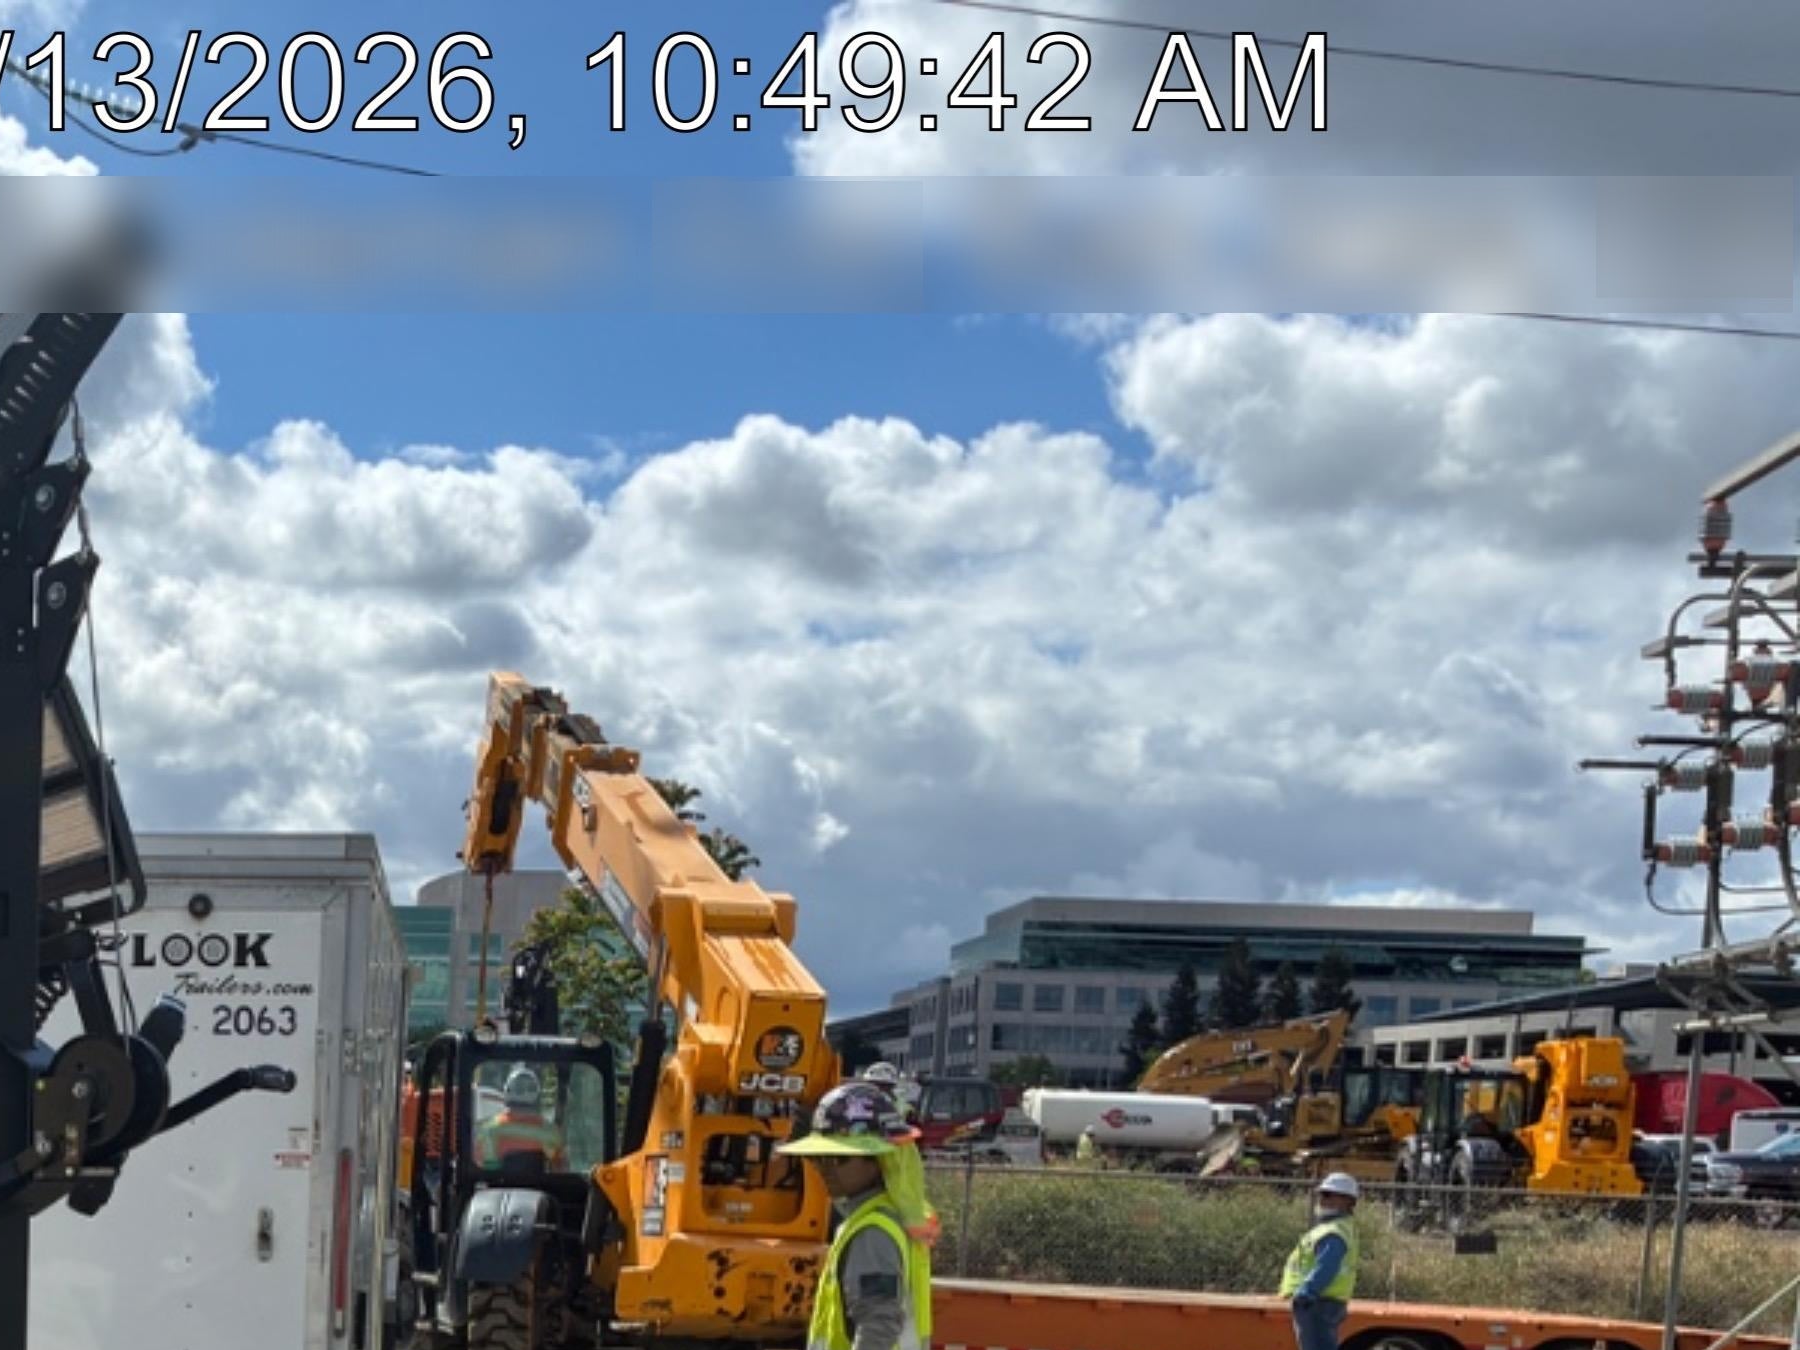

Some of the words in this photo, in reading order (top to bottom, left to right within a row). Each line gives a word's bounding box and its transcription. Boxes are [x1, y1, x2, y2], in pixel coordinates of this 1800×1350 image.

[131, 932, 273, 968] LOOK
[212, 1003, 297, 1037] 2063
[738, 1073, 805, 1093] JCB
